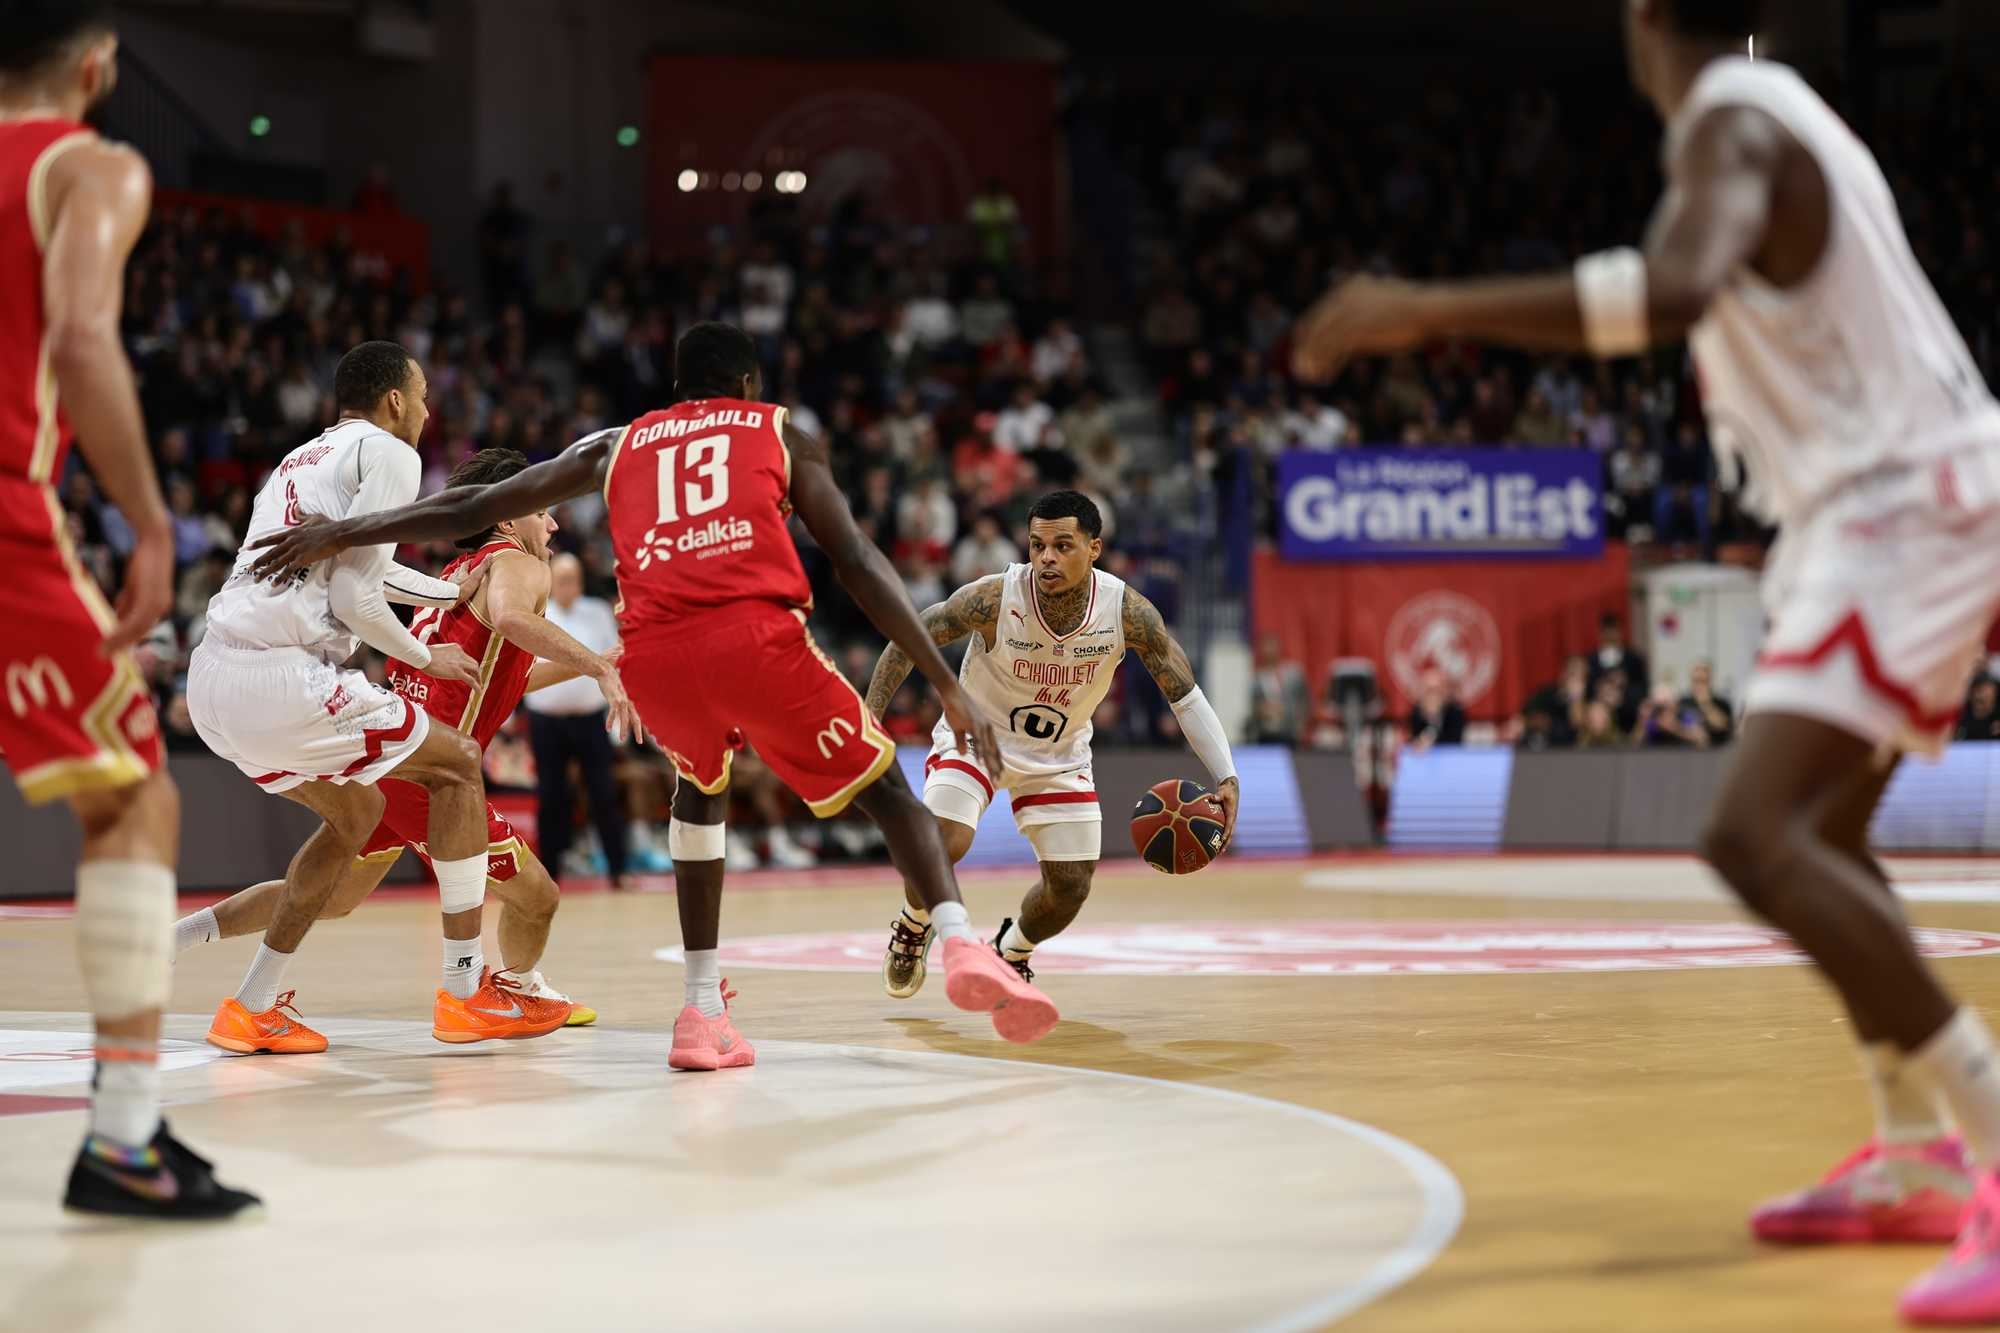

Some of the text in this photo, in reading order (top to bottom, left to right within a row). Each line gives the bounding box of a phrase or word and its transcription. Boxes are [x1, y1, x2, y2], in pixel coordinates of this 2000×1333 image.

[631, 410, 763, 450] GOMBAULD
[655, 433, 731, 525] 13
[676, 516, 753, 552] dalkia
[1013, 658, 1100, 687] CHOLET
